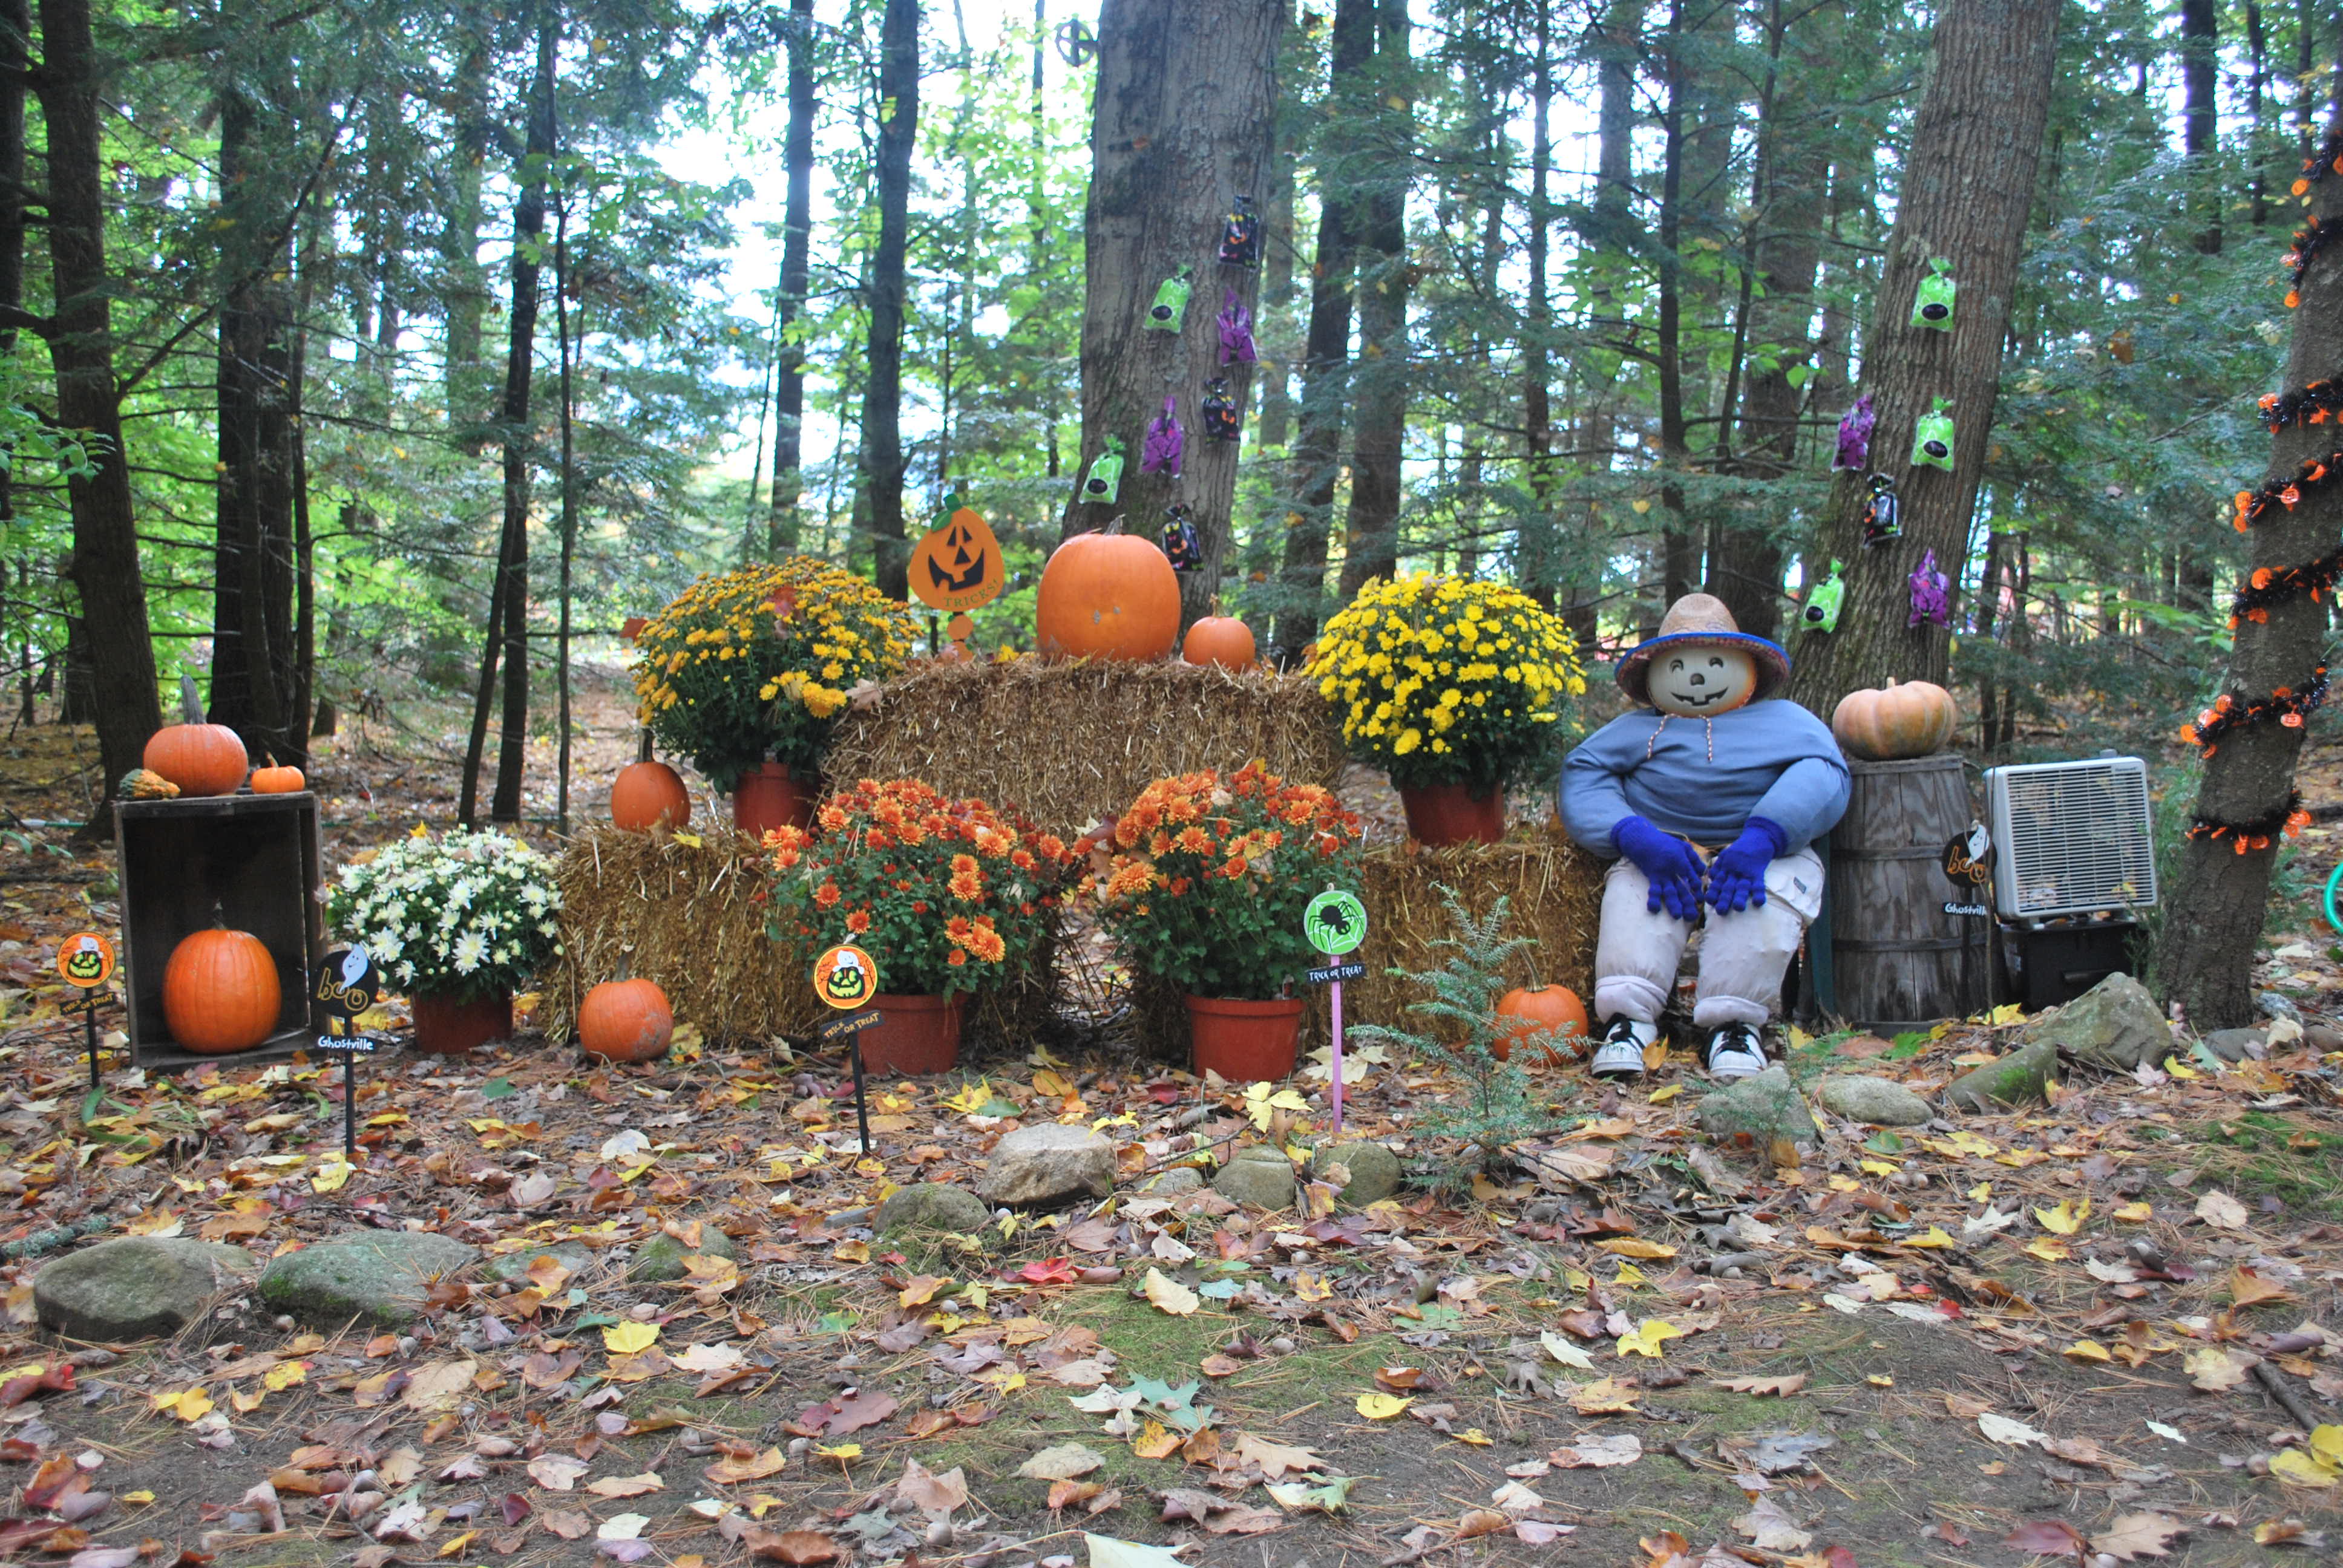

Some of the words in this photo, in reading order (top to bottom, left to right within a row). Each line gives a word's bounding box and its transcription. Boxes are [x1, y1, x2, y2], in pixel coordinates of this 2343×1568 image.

[1947, 844, 1987, 883] boo
[1309, 970, 1329, 982] TRICK
[1329, 969, 1340, 979] OR
[1341, 965, 1362, 978] TREAT
[317, 967, 369, 1011] boo
[824, 1021, 845, 1038] TRICK
[844, 1024, 855, 1033] OR
[854, 1012, 880, 1028] TREAT
[318, 1035, 374, 1051] Ghostville
